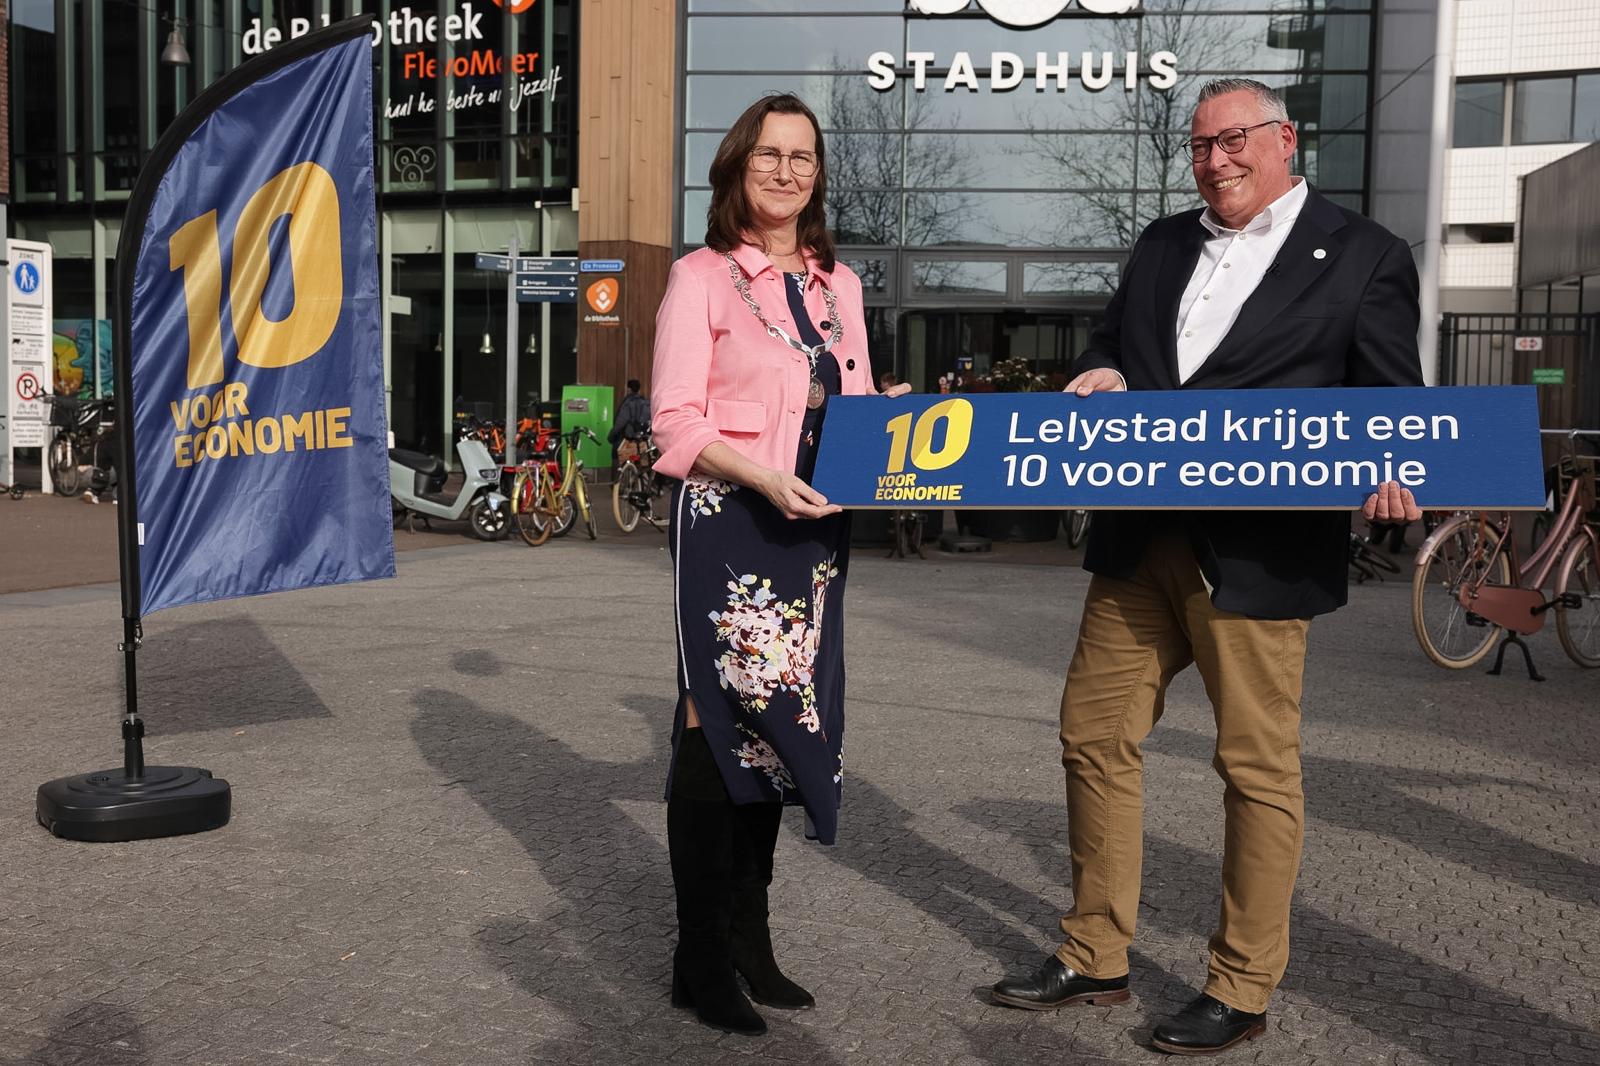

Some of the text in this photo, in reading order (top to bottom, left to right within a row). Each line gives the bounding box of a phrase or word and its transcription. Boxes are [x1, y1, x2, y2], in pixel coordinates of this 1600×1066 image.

[242, 18, 282, 55] de
[404, 49, 539, 80] FleoMer
[867, 51, 1178, 90] STADHUIS
[384, 95, 414, 119] haal
[417, 91, 437, 112] he
[446, 85, 484, 111] beste
[509, 65, 563, 112] jezelf
[169, 160, 343, 391] 10
[170, 381, 249, 432] VOOR
[174, 406, 353, 468] ECONOMIE
[885, 397, 975, 474] 10
[1007, 408, 1459, 451] Lelystad krijgt een
[876, 472, 917, 489] VOOR
[1002, 451, 1427, 488] 10 voor economie
[874, 484, 964, 501] ECONOMIE
